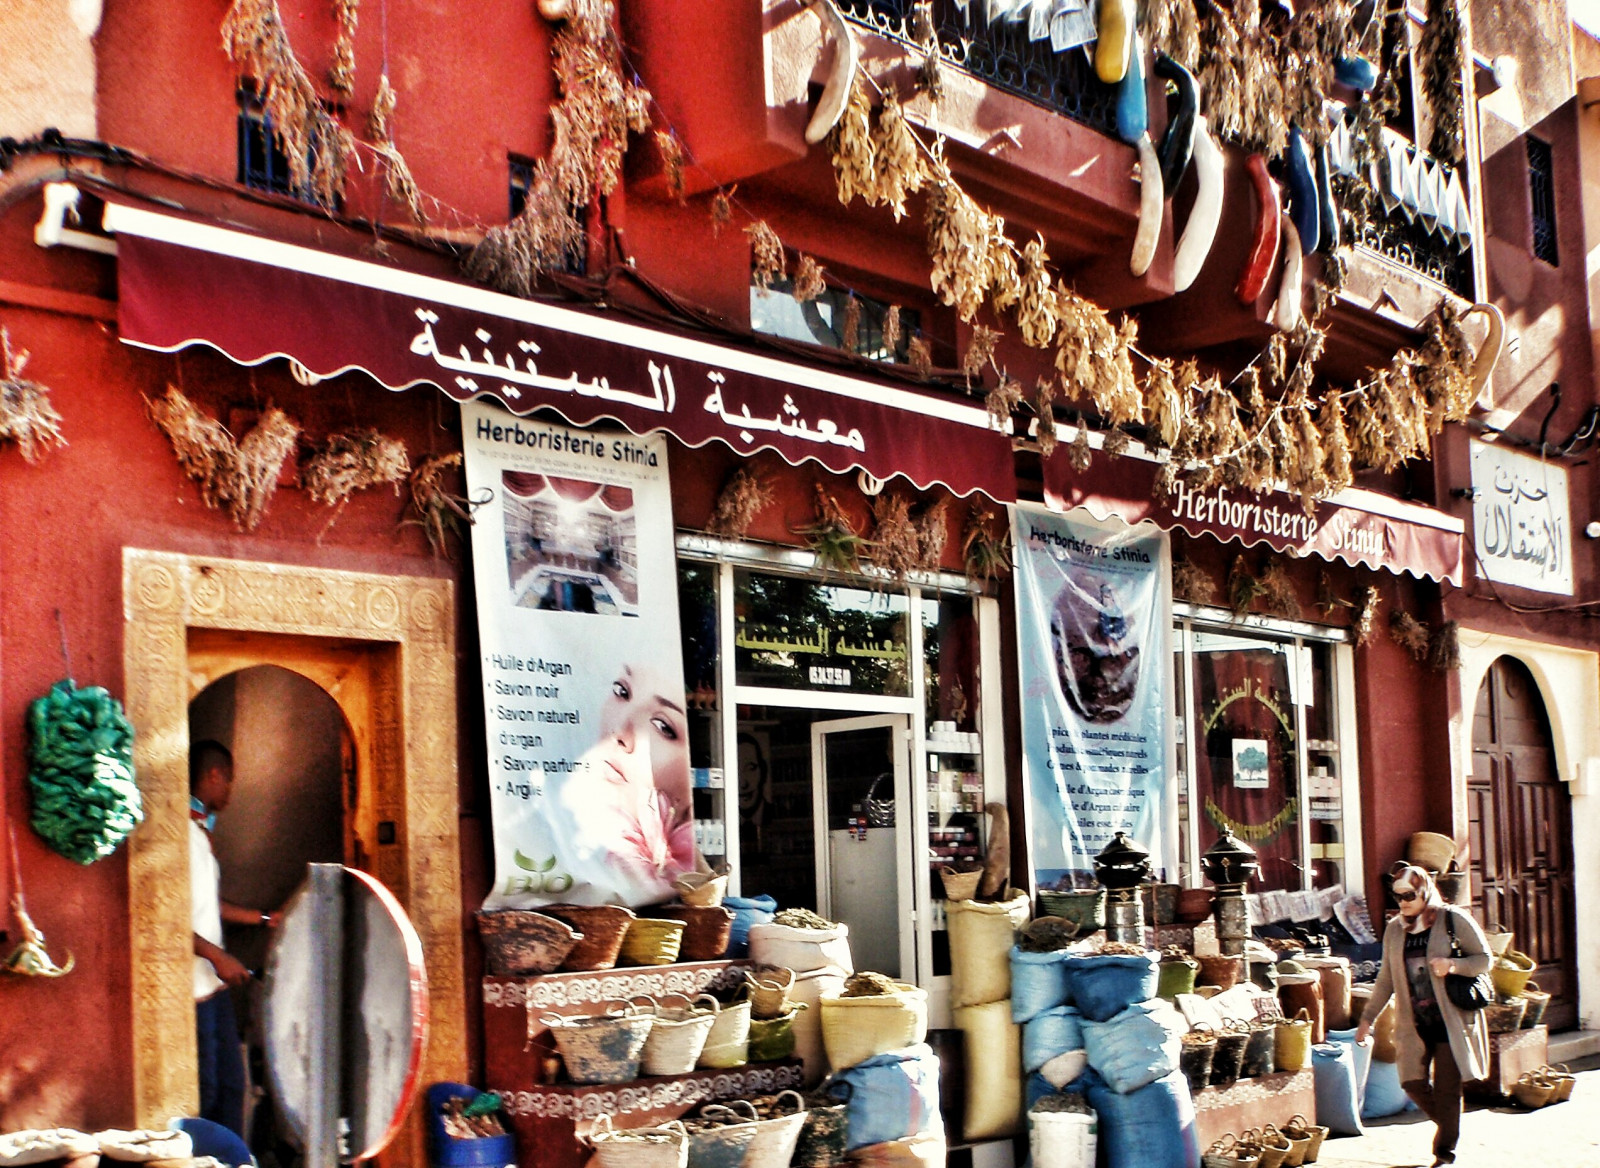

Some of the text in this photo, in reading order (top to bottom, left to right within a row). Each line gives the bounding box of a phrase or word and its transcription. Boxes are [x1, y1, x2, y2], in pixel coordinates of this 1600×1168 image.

[410, 307, 866, 453] معشبة الستينية
[477, 418, 606, 458] Herboristerie
[612, 441, 659, 467] Stinia
[1171, 479, 1386, 557] Herboristerie Stinia
[1113, 546, 1151, 564] Stinia
[492, 653, 572, 678] Huile d'Argan
[495, 679, 559, 699] Savon noir
[497, 704, 580, 724] Savon naturel
[503, 756, 539, 771] Savon
